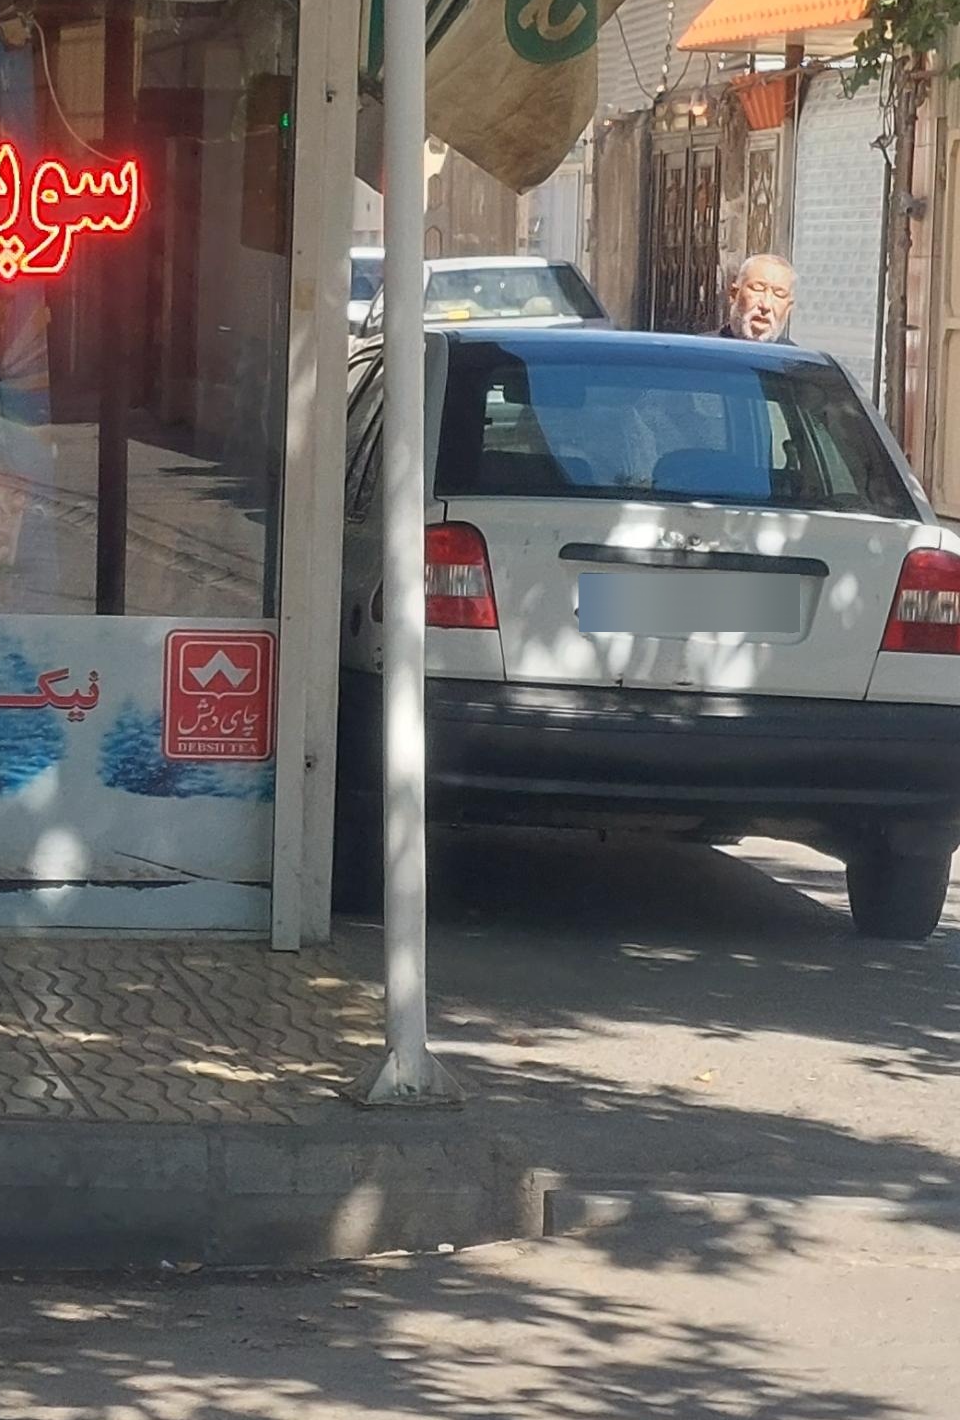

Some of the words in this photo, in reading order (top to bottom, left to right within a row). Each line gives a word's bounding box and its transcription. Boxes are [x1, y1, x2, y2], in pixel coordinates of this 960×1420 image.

[177, 698, 216, 735] دبش
[220, 705, 259, 737] چای
[228, 742, 257, 753] TEA
